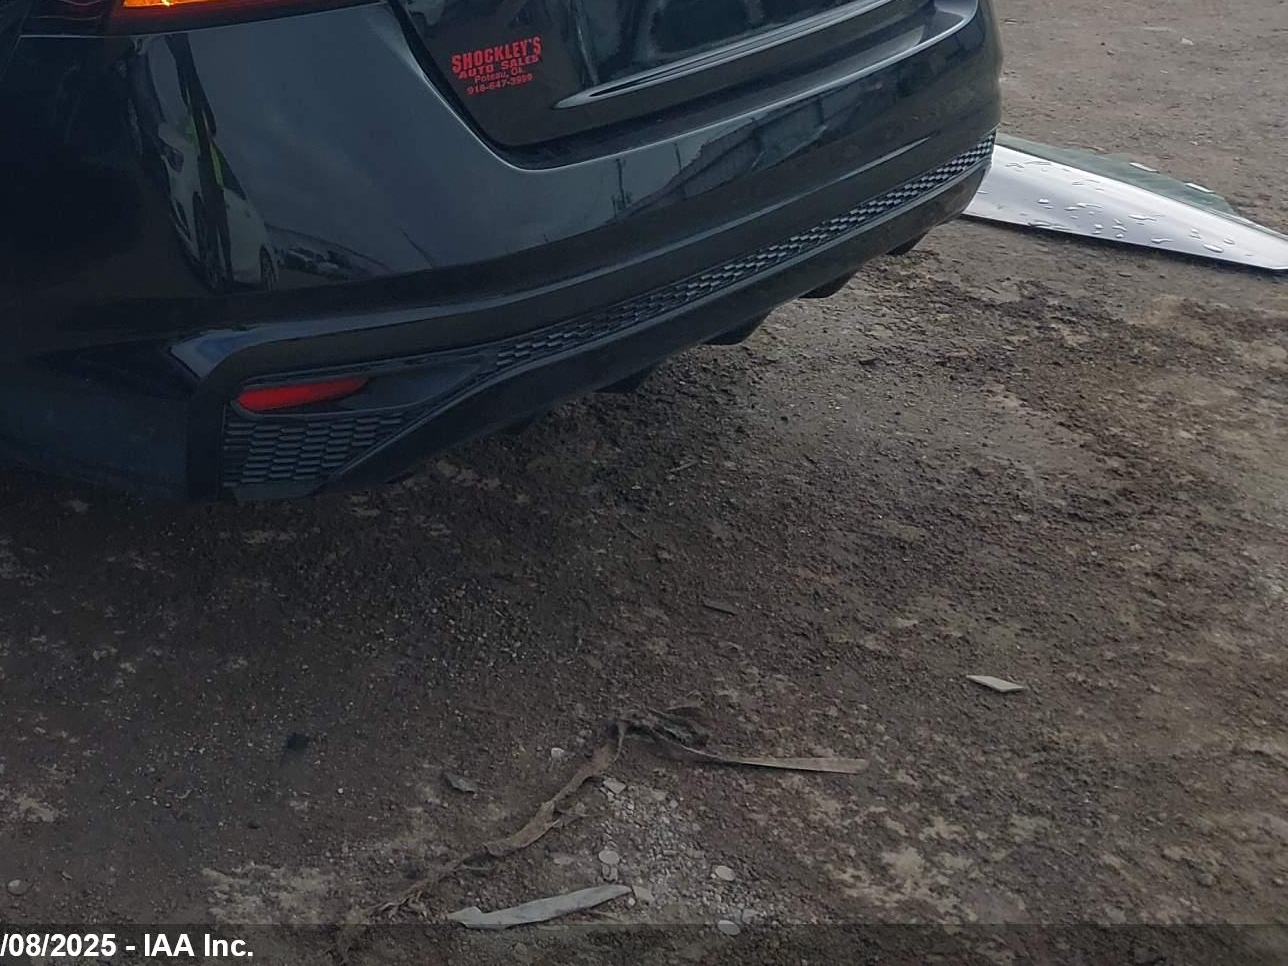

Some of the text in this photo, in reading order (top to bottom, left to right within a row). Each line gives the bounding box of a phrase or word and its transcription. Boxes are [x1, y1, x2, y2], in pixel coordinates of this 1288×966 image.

[452, 36, 541, 74] SHOCKLEY'S
[458, 55, 539, 80] AUTO SALES
